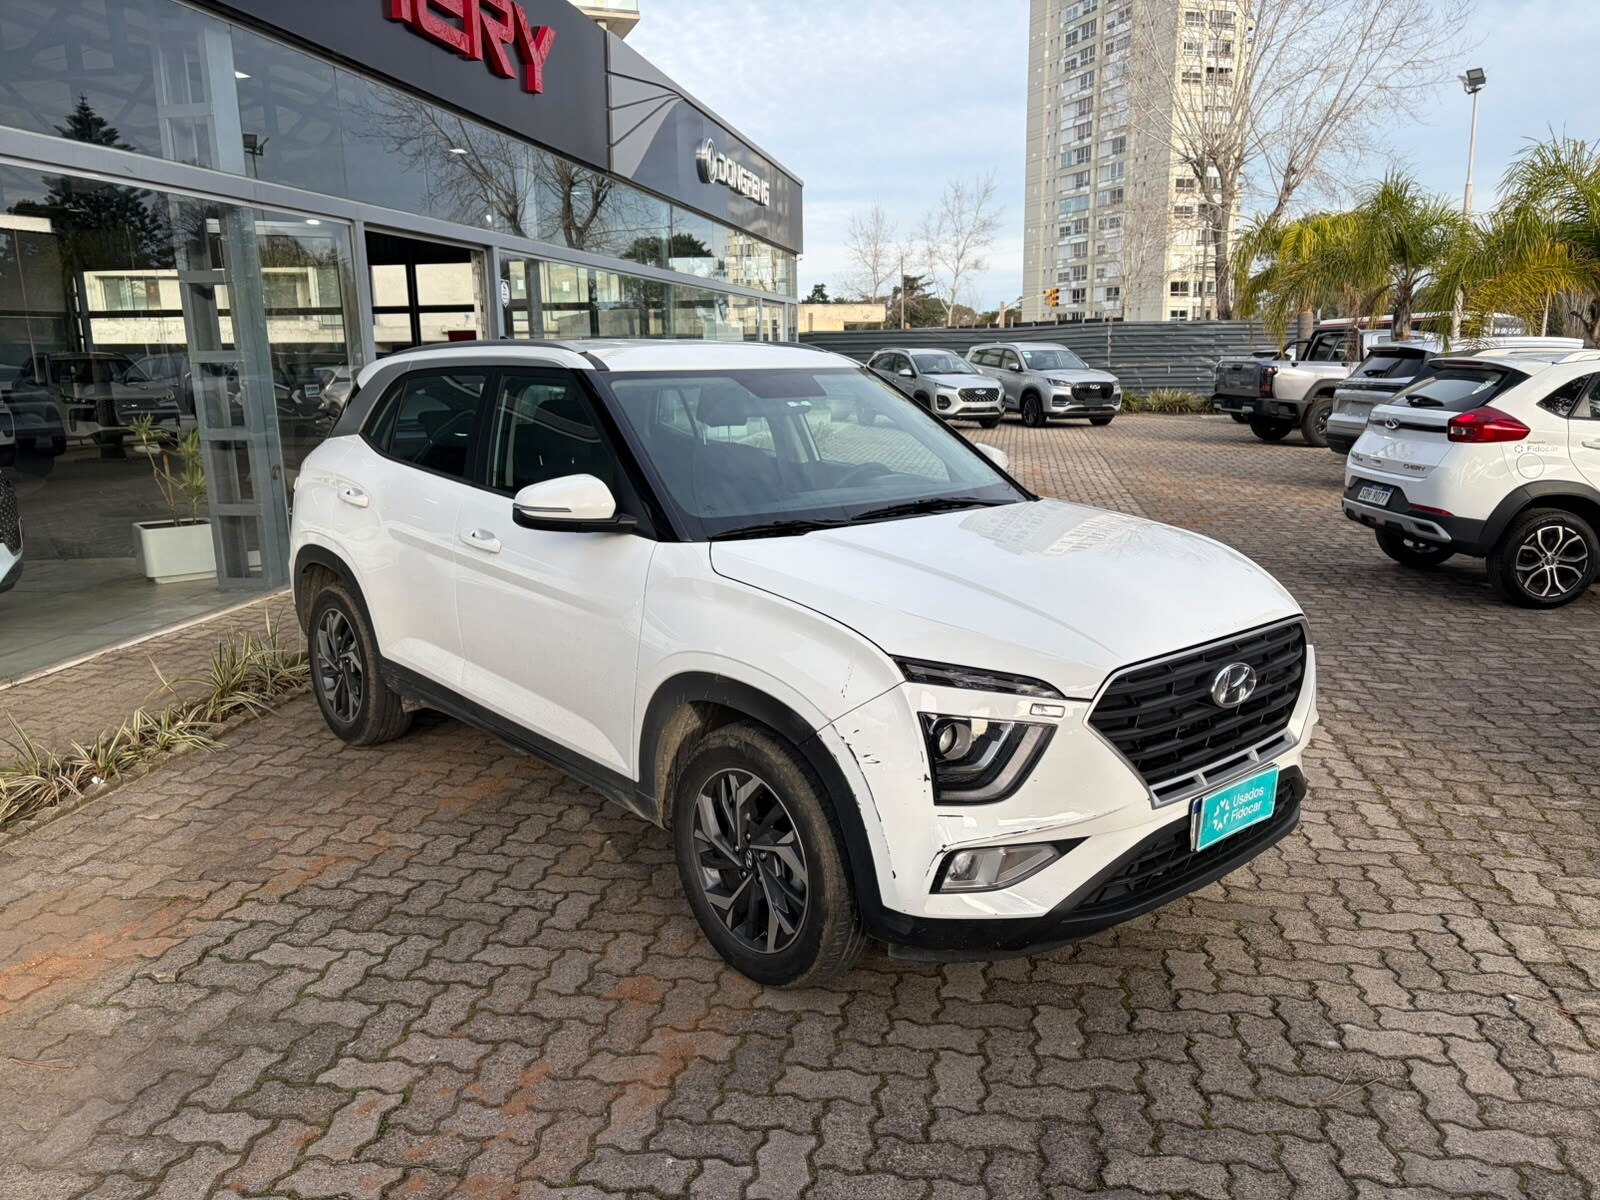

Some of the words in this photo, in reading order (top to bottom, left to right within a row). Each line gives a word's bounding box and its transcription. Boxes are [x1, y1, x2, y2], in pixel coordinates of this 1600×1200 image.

[716, 152, 770, 207] DONGFENG
[1527, 445, 1559, 453] Fidocar
[1233, 786, 1264, 807] Usados
[1231, 800, 1262, 823] Fidocar
